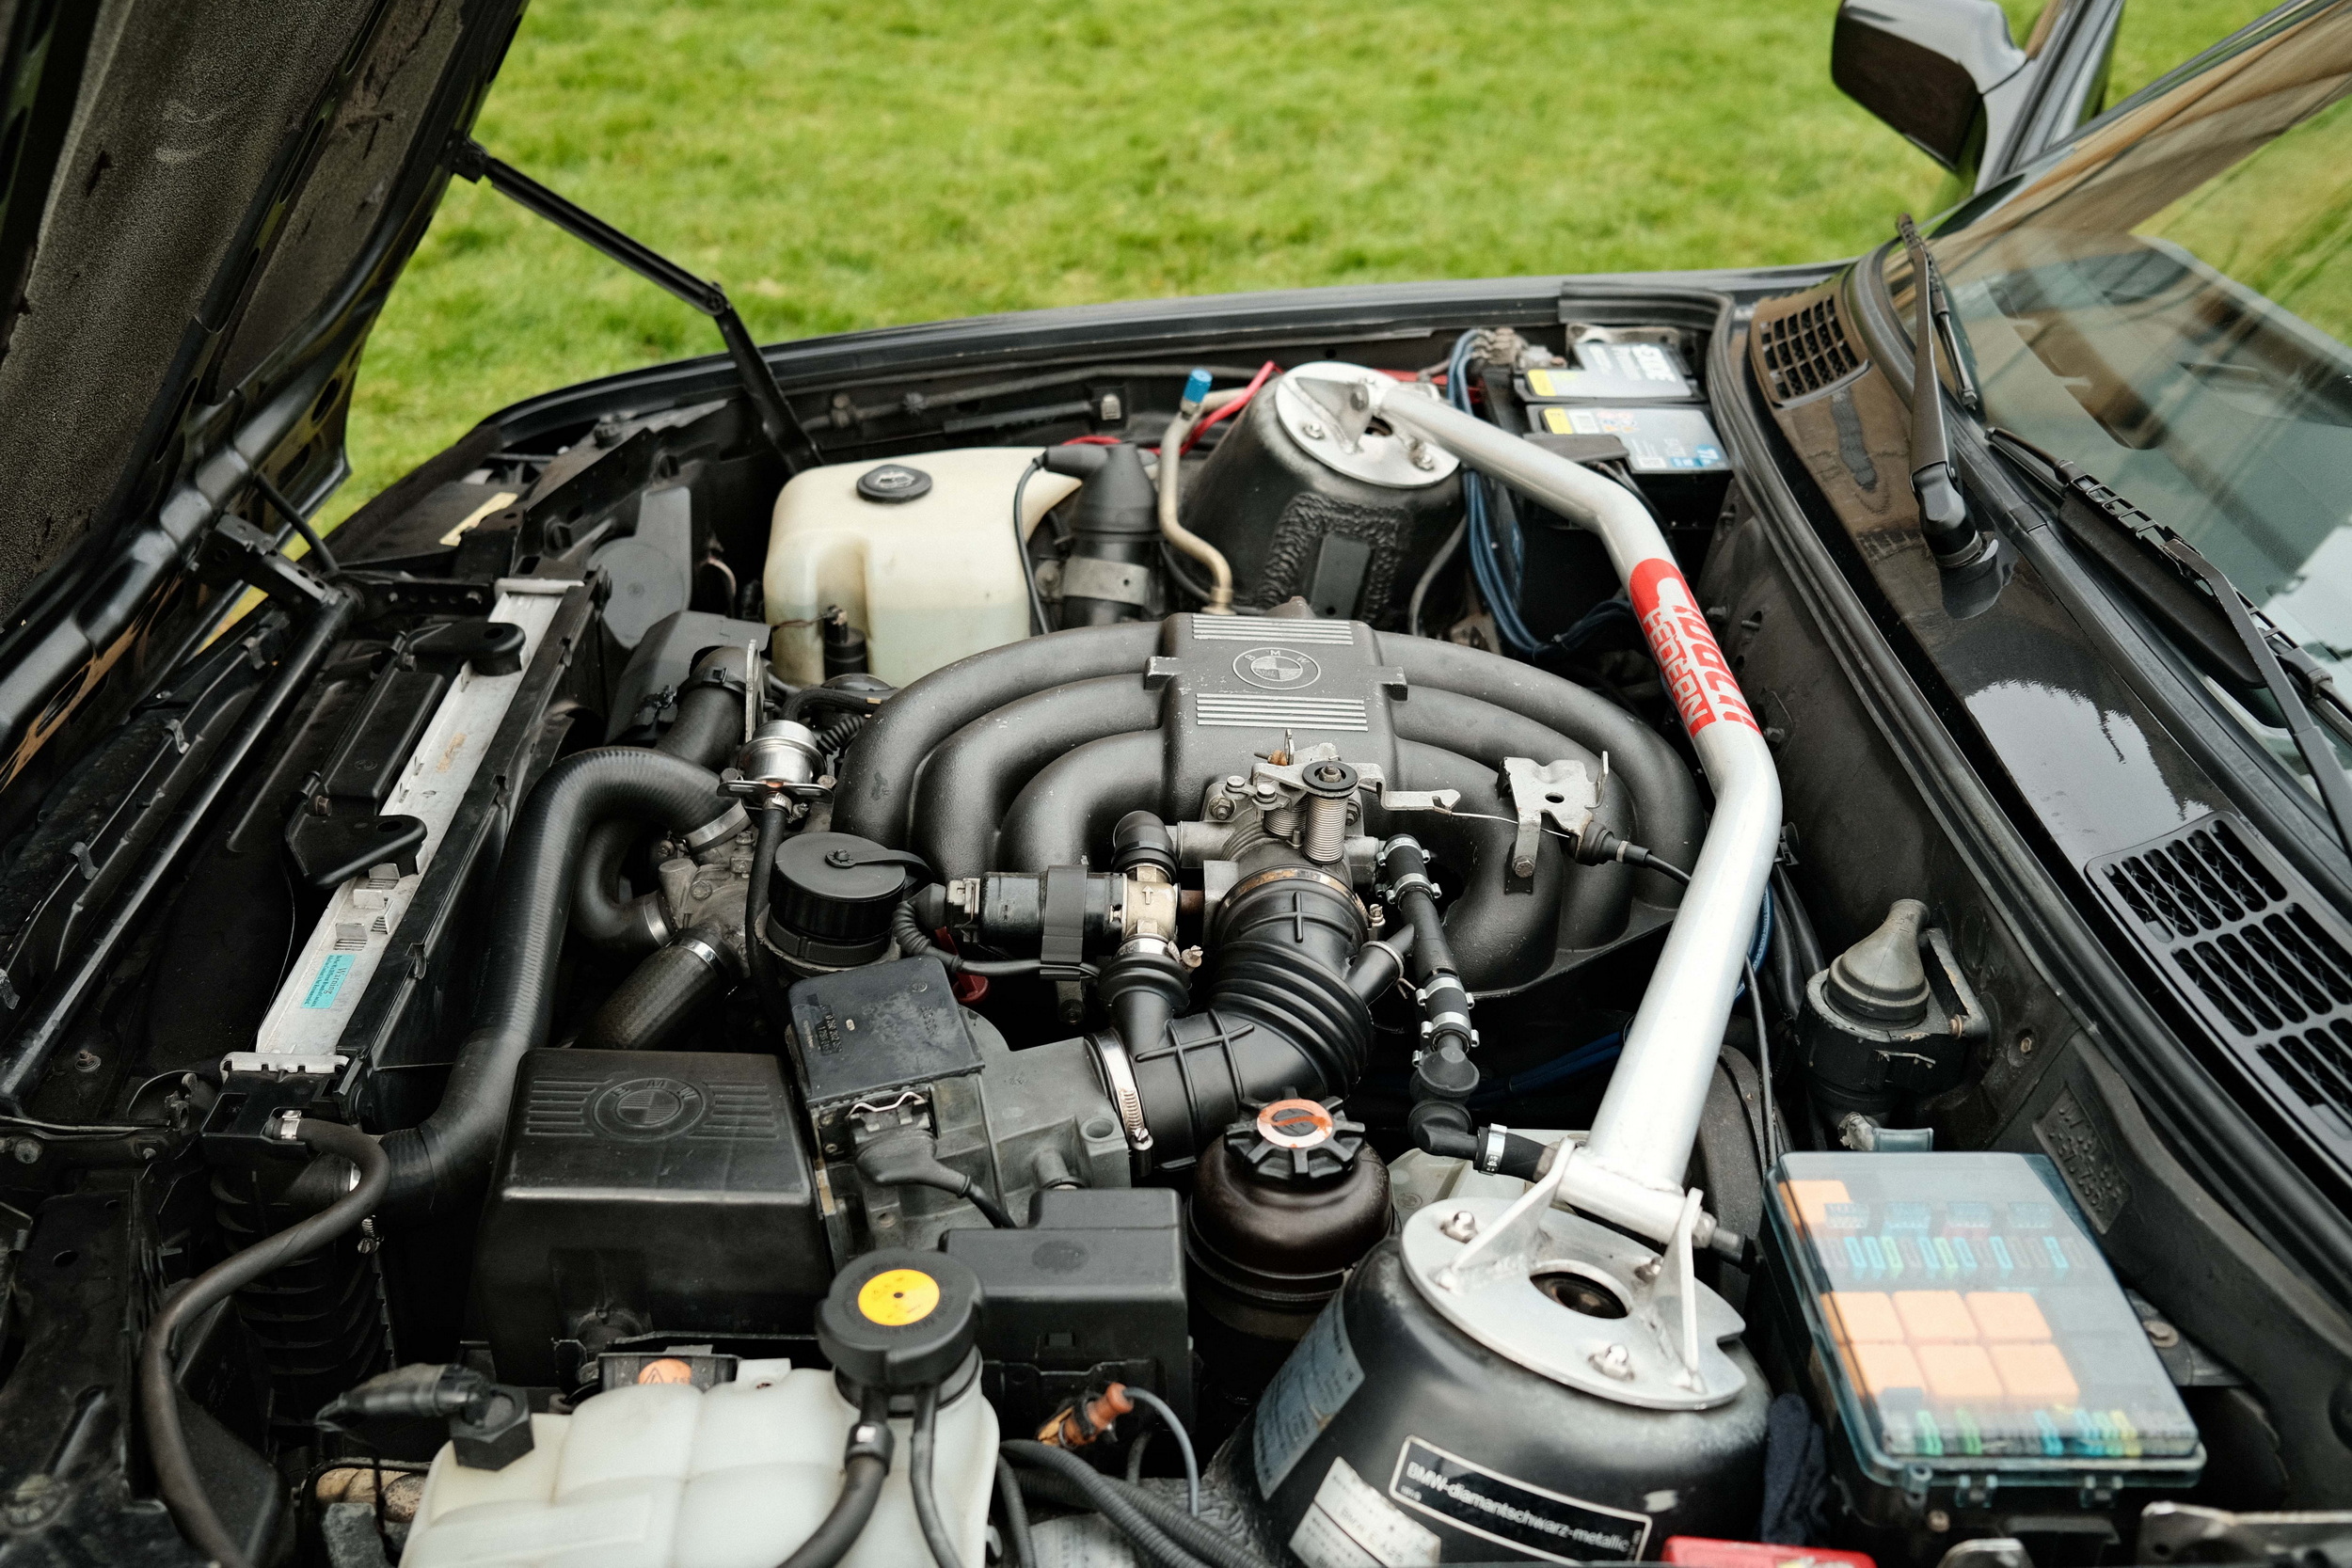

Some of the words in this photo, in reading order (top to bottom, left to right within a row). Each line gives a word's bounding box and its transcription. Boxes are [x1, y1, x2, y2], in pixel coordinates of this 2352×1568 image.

[1245, 649, 1310, 664] BMW
[1643, 610, 1708, 725] FEDERN
[323, 967, 347, 994] Warning
[614, 1080, 698, 1100] BMW
